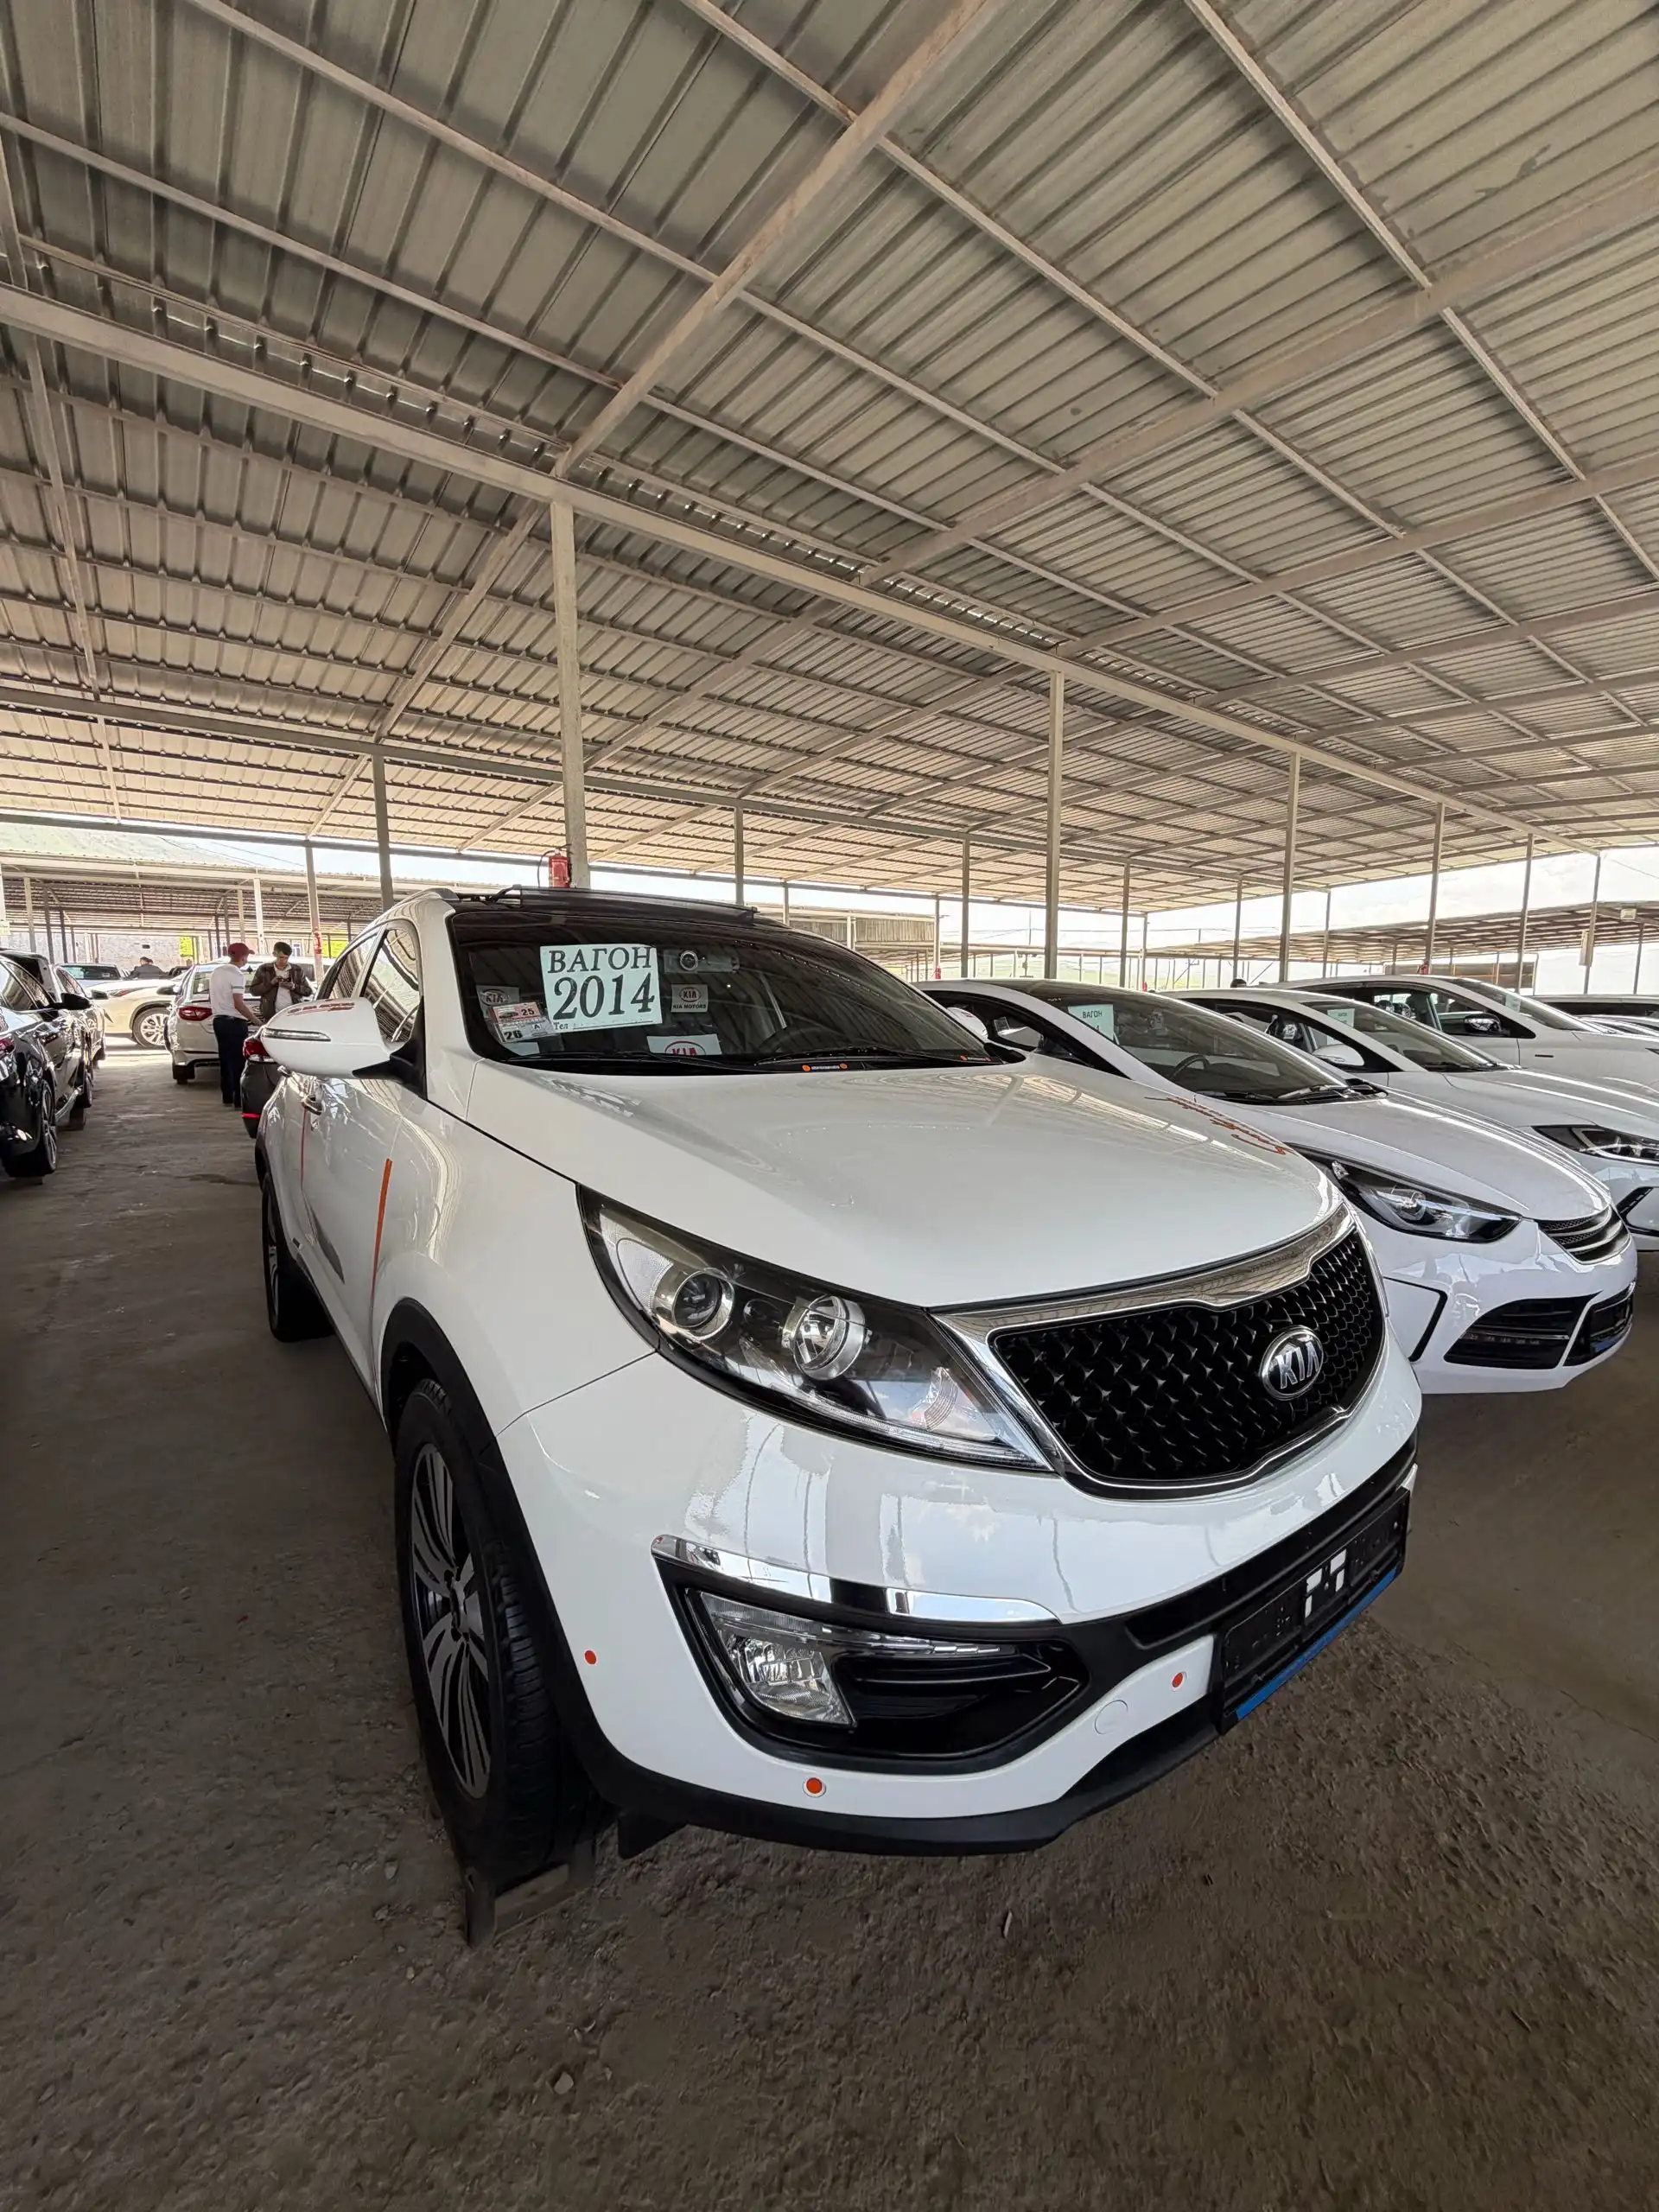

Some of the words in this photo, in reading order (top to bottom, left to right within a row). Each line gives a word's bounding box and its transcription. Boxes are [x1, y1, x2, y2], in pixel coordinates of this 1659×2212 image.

[548, 947, 652, 973] ВАГОН
[553, 972, 655, 1020] 2014
[520, 1007, 535, 1017] 25
[1082, 1010, 1103, 1019] ВАГОН
[1274, 1341, 1320, 1389] KIA
